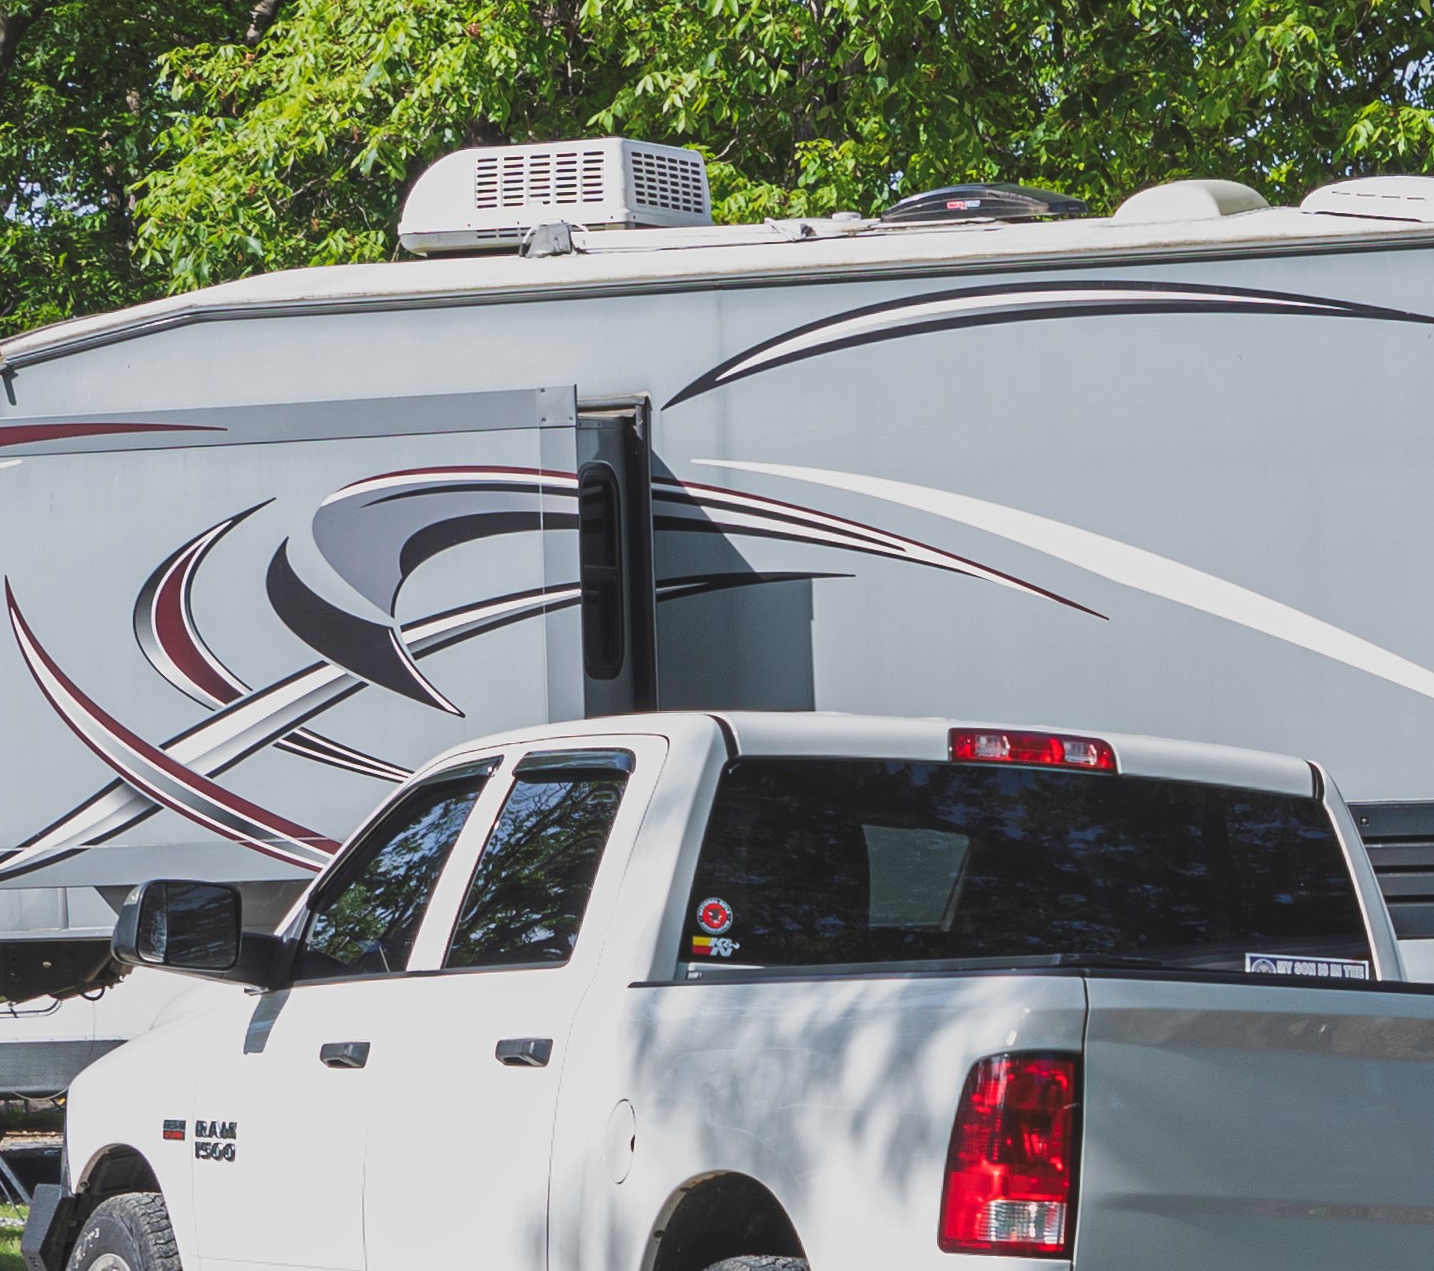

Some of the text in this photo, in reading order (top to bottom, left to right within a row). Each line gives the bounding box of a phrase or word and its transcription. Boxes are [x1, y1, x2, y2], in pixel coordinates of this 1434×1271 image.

[1294, 962, 1317, 976] SON
[195, 1120, 237, 1139] RAM
[195, 1141, 236, 1162] 1500
